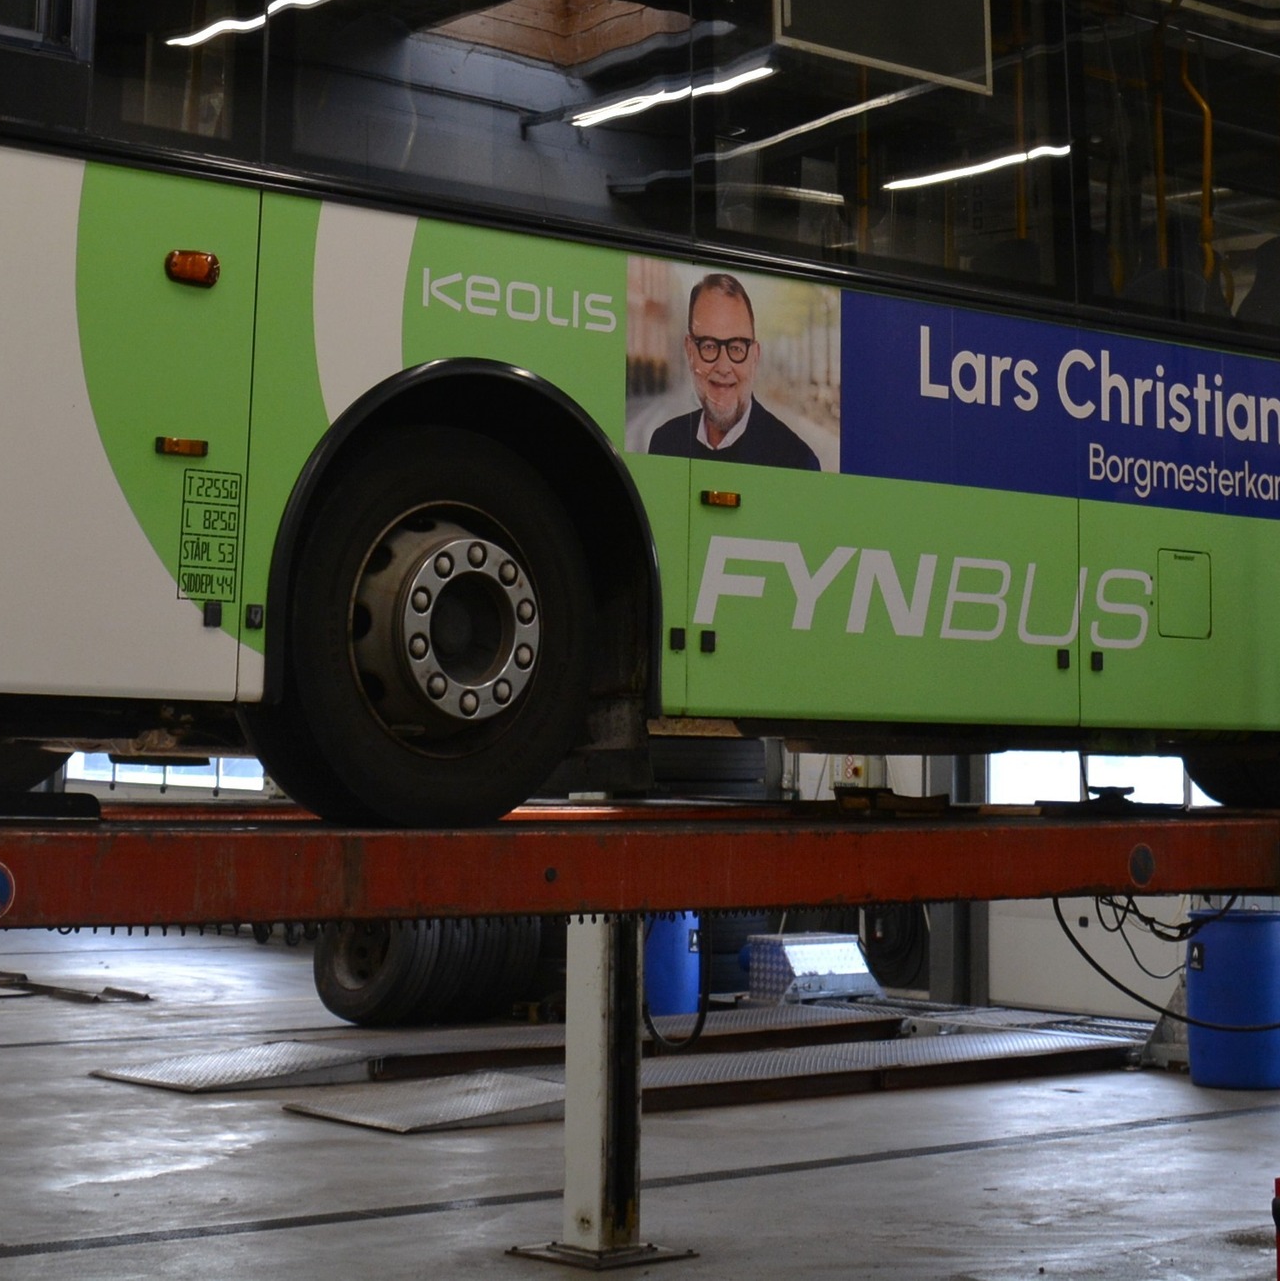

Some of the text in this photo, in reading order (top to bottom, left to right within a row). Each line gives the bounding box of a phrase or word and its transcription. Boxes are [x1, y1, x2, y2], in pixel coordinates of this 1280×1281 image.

[920, 325, 1039, 412] Lars
[196, 477, 238, 500] 22550
[185, 508, 237, 532] L 8250
[183, 537, 235, 563] STÅPL 53
[181, 572, 233, 595] SIDDEPL 44
[692, 535, 1154, 650] FYNBUS
